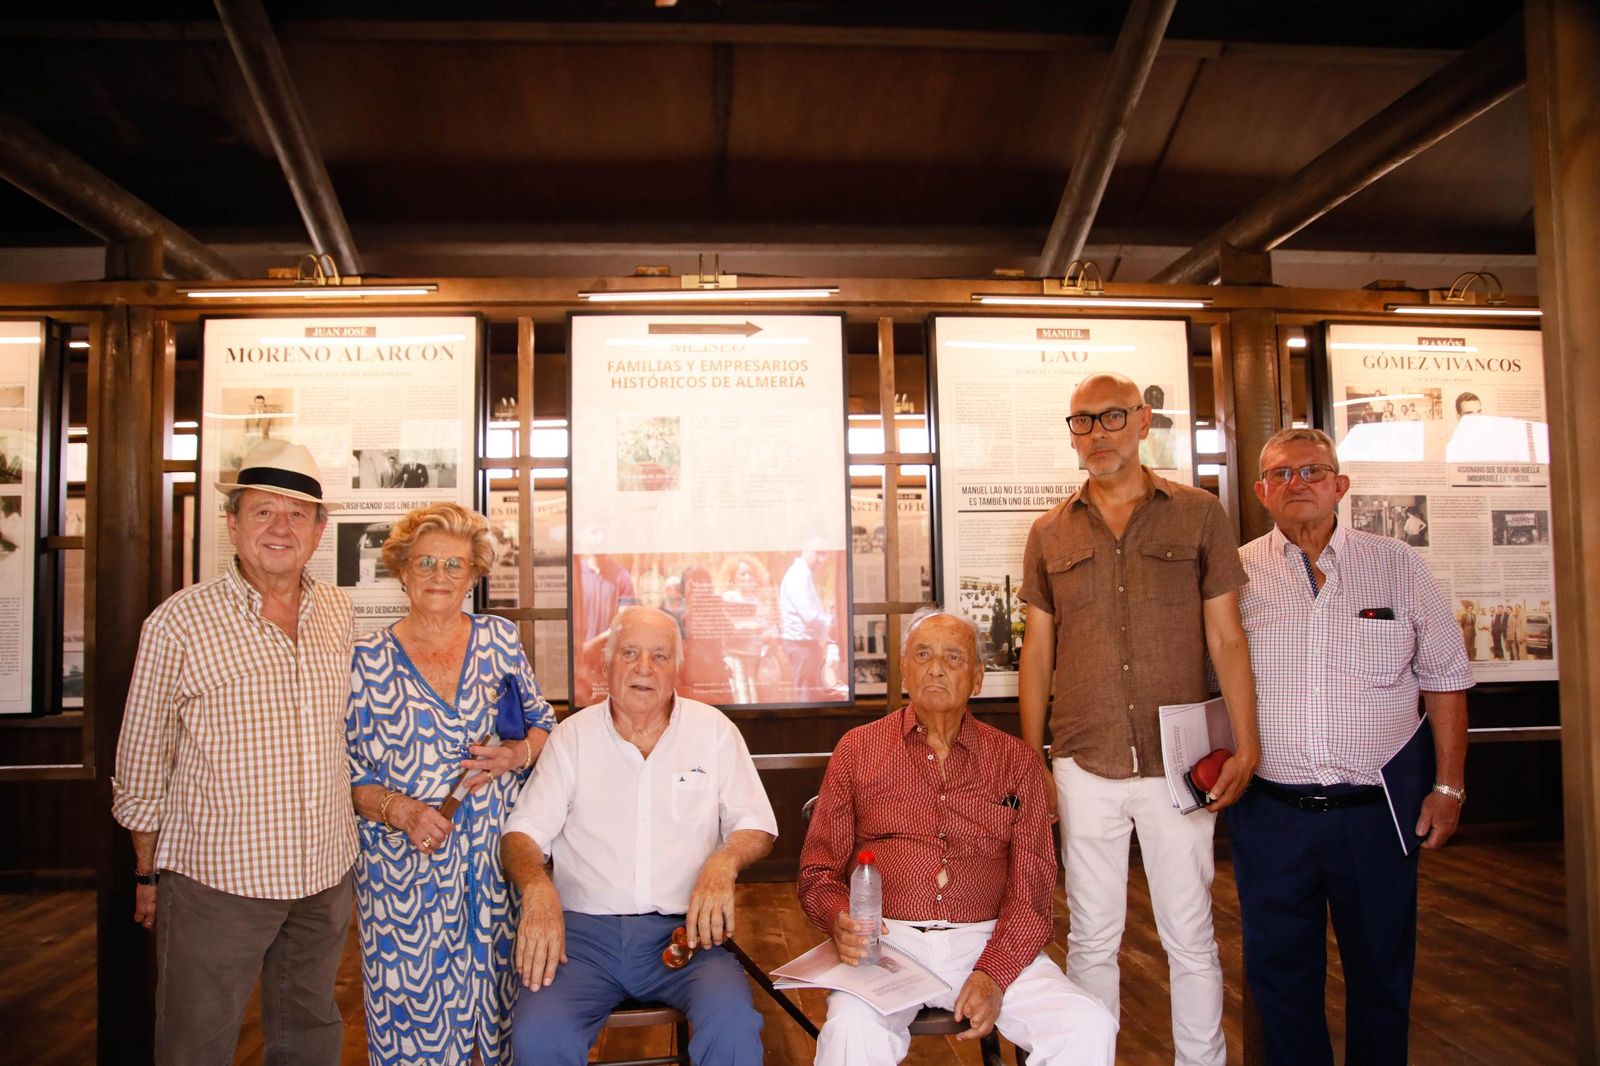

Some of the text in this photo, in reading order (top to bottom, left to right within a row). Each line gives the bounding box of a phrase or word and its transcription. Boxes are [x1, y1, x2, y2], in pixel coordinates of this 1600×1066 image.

[312, 327, 340, 337] JUAN
[1042, 329, 1084, 338] MANUEL
[224, 344, 331, 363] MORENO
[1040, 350, 1089, 363] LAO
[607, 359, 809, 373] FAMILIAS Y EMPRESARIOS
[1362, 351, 1522, 373] GÓMEZ VIVANCOS
[611, 373, 805, 389] HISTÓRICOS DE ALMERÍA
[1486, 465, 1496, 473] QUE
[1510, 465, 1520, 473] UNA
[1520, 465, 1540, 474] HUELLA
[961, 486, 988, 495] MANUEL
[989, 486, 1002, 494] LAO
[1003, 486, 1013, 494] NO
[1014, 486, 1022, 494] ES
[1041, 485, 1055, 494] UNO
[1056, 485, 1064, 494] DE
[1065, 485, 1077, 494] LOS
[341, 502, 382, 510] ERSIFICANDO
[383, 501, 395, 509] SUS
[969, 497, 977, 506] ES
[978, 496, 1008, 506] TAMBIÉN
[1008, 497, 1022, 505] UNO
[1023, 496, 1031, 505] DE
[1033, 496, 1044, 505] LOS
[366, 606, 374, 614] SU
